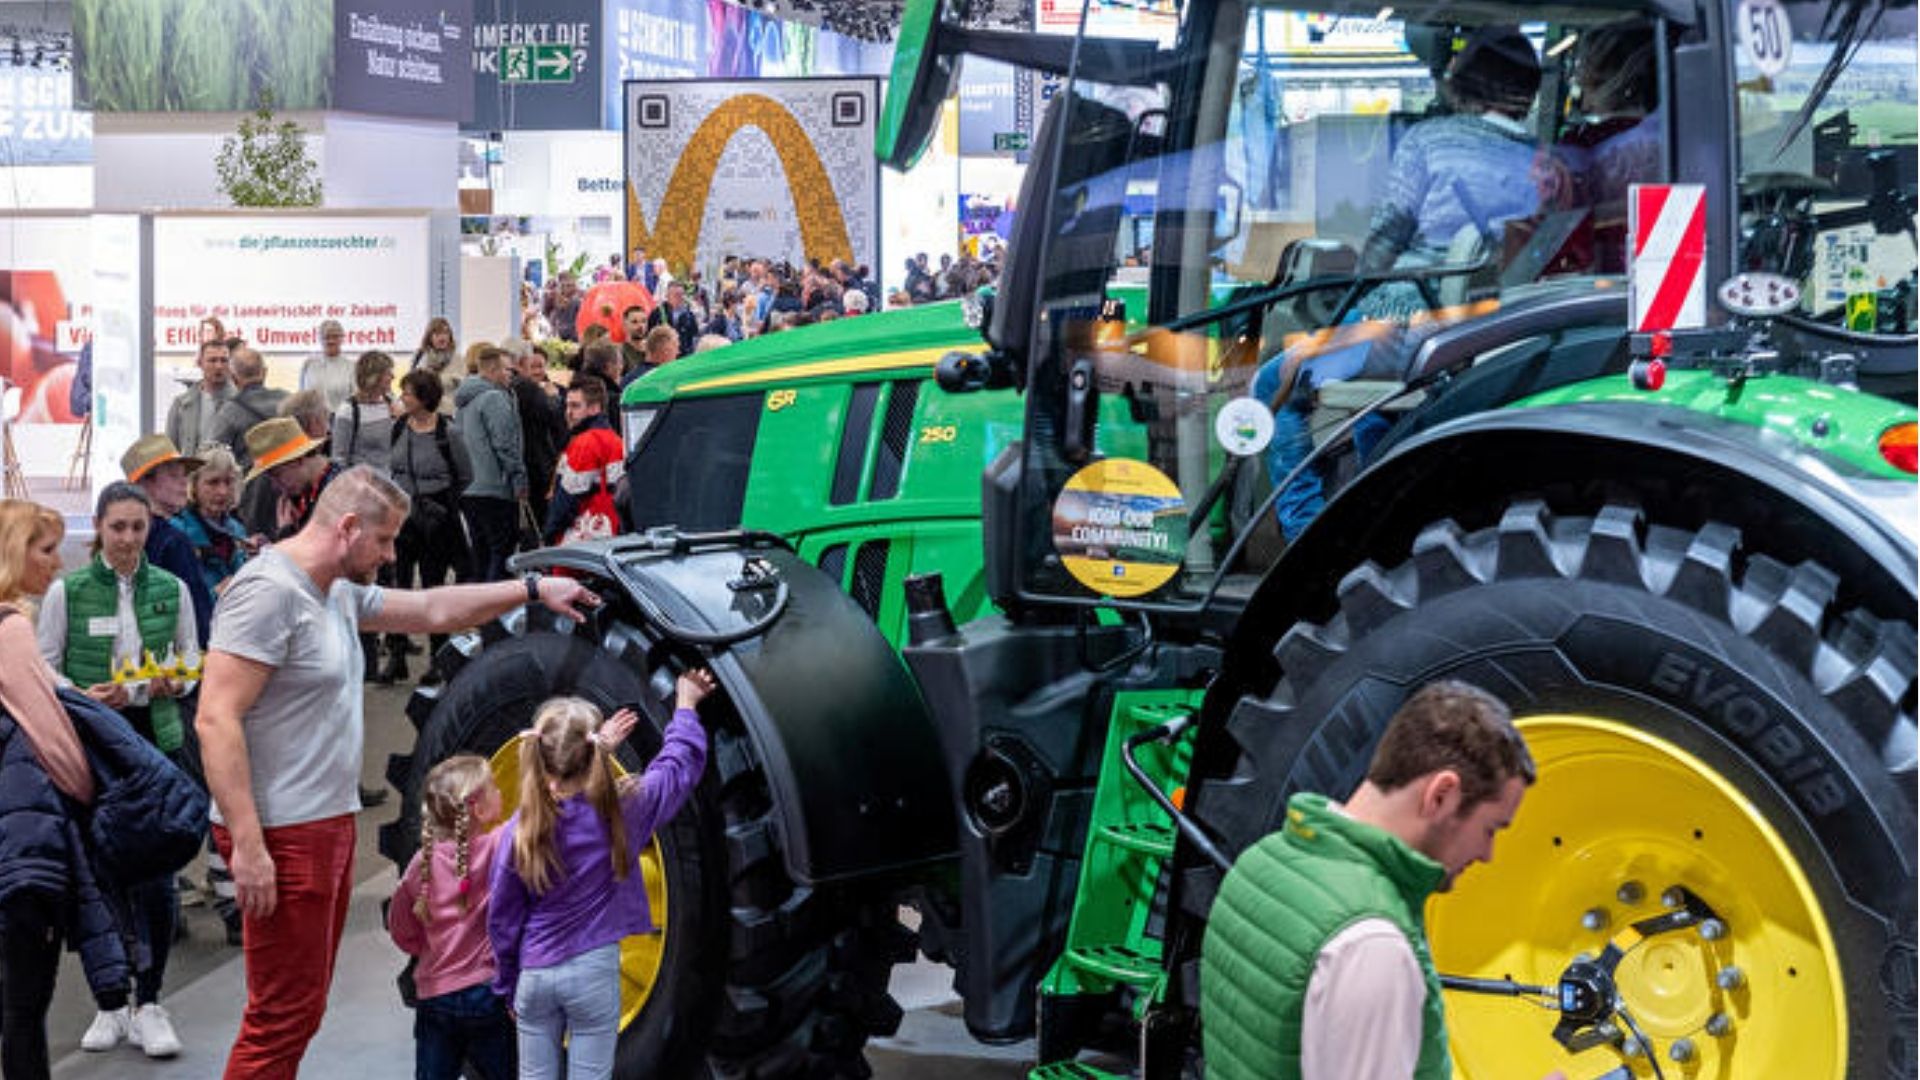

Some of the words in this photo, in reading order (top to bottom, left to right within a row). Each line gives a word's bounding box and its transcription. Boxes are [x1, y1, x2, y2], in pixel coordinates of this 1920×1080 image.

[556, 22, 591, 46] DIE
[1750, 5, 1784, 60] 50
[767, 389, 798, 412] 6R
[919, 425, 957, 445] 250
[1088, 506, 1121, 524] JOIN
[1122, 510, 1154, 528] OUR
[1072, 525, 1168, 551] COMMUNITY!
